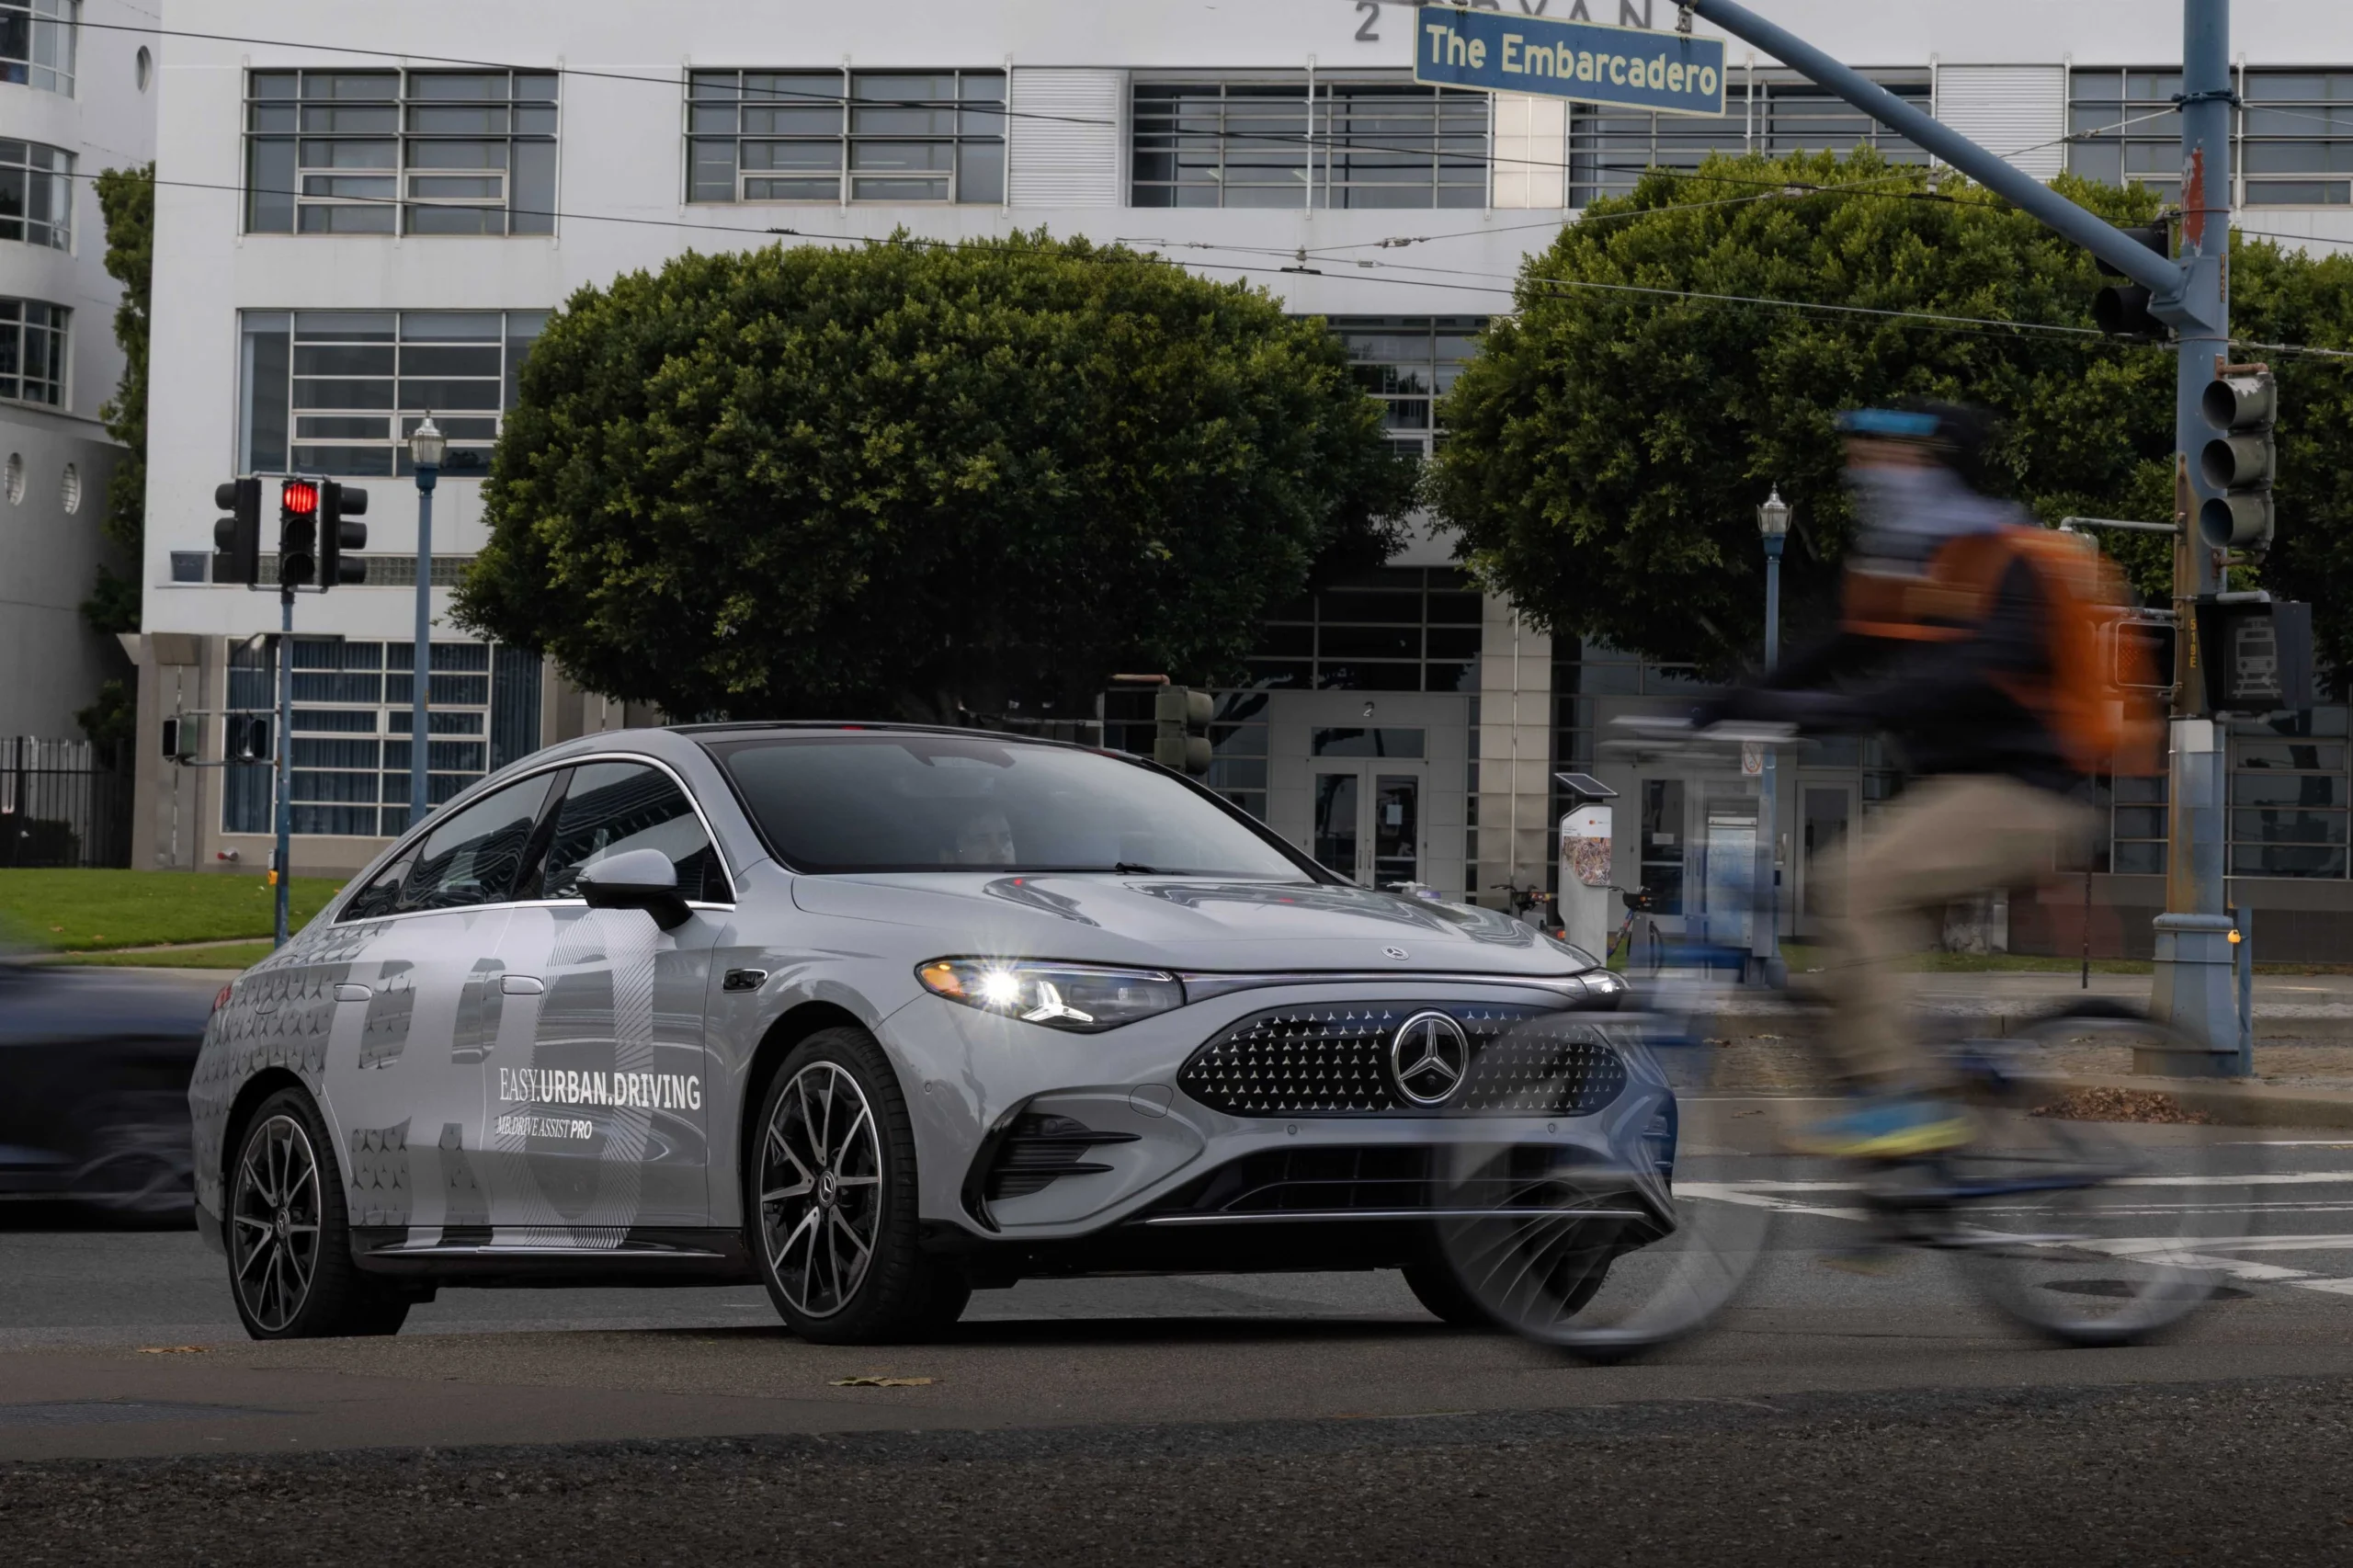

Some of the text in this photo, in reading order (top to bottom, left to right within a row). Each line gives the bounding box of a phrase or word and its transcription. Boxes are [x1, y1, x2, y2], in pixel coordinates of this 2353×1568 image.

[1355, 2, 1380, 41] 2
[1426, 24, 1718, 97] The Embarcadero
[1363, 700, 1375, 717] 2
[499, 1067, 701, 1110] EASY.URBAN.DRIVING
[496, 1115, 593, 1140] MB.DRIVE ASSIST PRO
